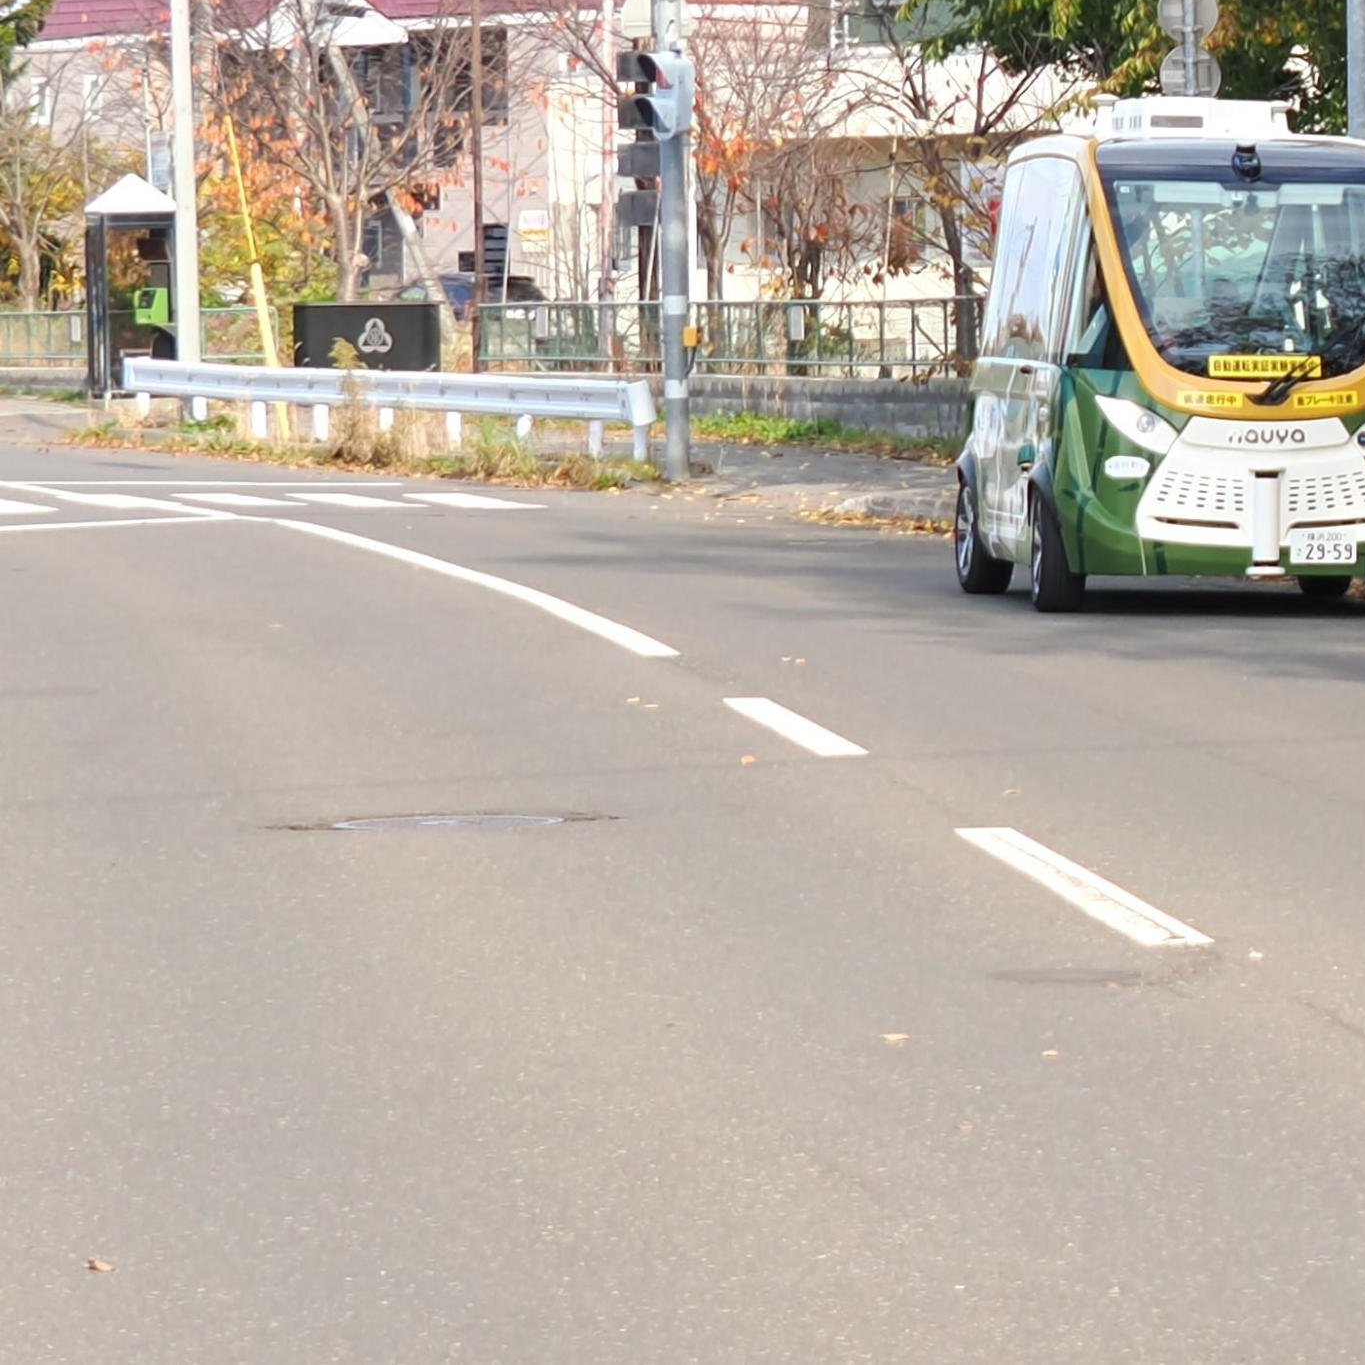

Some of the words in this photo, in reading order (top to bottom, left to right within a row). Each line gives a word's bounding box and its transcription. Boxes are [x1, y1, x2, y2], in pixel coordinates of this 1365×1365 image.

[1296, 394, 1353, 405] 急ブレーキ注意
[1305, 543, 1353, 560] 29-59
